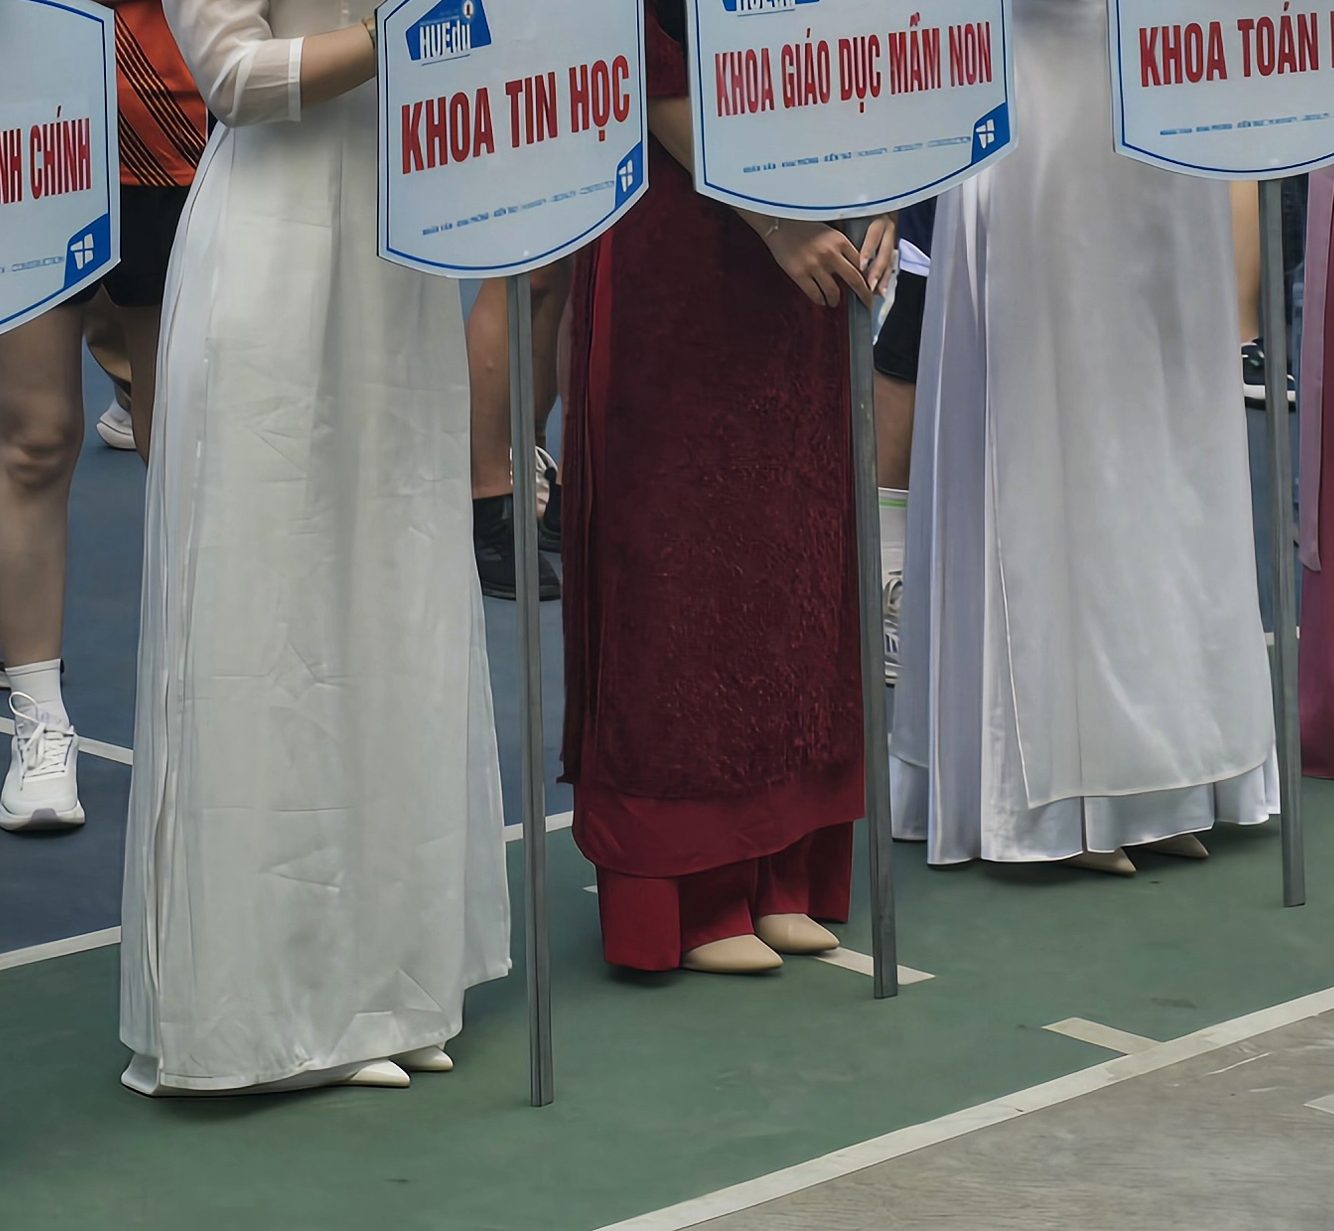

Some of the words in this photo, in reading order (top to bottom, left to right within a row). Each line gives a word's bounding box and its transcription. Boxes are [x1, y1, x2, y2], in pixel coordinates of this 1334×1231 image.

[714, 47, 775, 117] KHOA
[780, 27, 831, 109] GIÁO
[837, 34, 882, 114] DỤC
[887, 11, 942, 96] MẦM
[948, 21, 993, 88] NON
[1139, 21, 1228, 88] KHOA
[1237, 1, 1320, 78] TOÁN
[28, 105, 92, 200] CHÍNH
[401, 87, 495, 175] KHOA
[505, 71, 559, 149] TIN
[568, 54, 630, 142] HỌC
